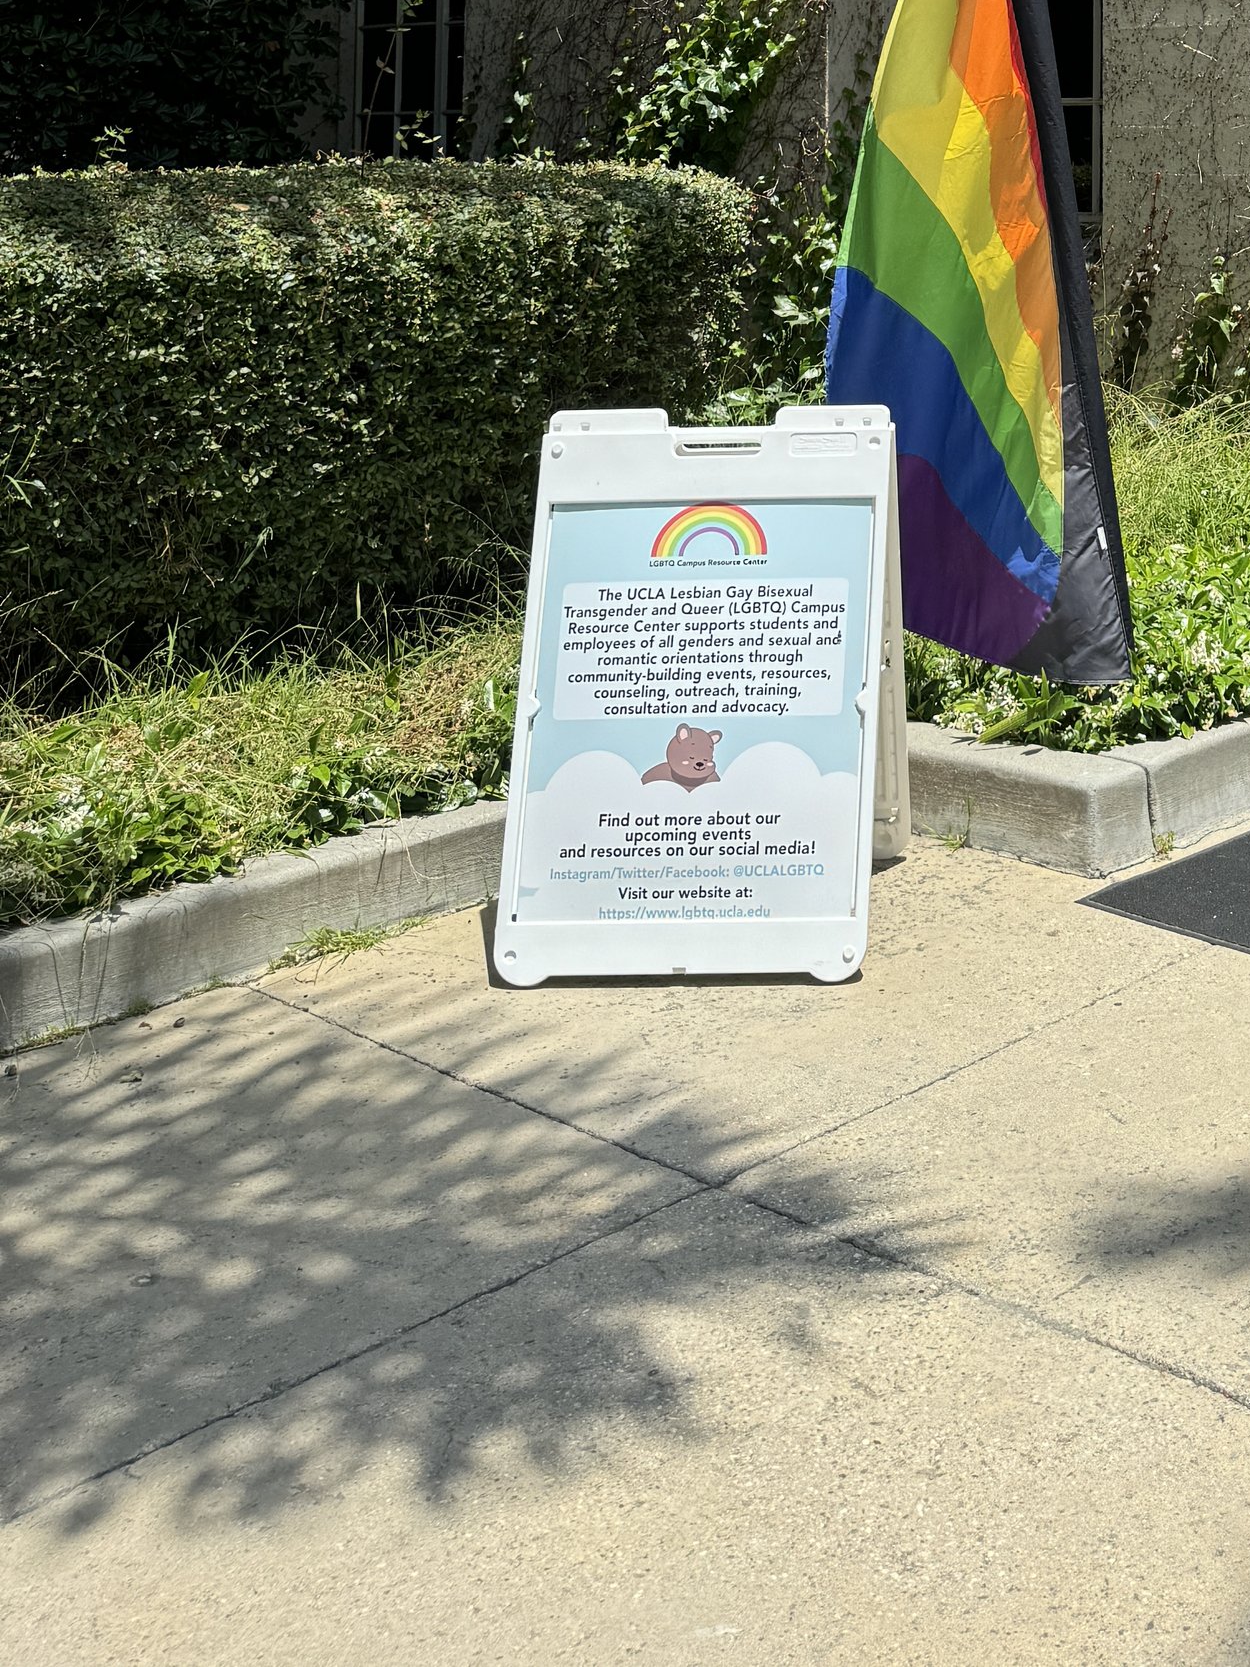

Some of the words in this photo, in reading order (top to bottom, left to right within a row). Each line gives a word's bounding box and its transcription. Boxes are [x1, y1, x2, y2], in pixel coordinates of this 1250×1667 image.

[650, 560, 675, 568] LGBTQ
[677, 560, 706, 568] Campus
[598, 588, 622, 601] The
[628, 588, 666, 600] UCLA
[670, 586, 721, 599] Lesbian
[727, 586, 753, 601] Gay
[758, 584, 813, 597] Bisexual
[564, 604, 648, 621] Transgender
[651, 602, 676, 616] and
[681, 603, 724, 614] Queer
[728, 600, 787, 616] (LGBTQ)
[791, 601, 845, 616] Campus
[568, 622, 629, 634] Resource
[634, 620, 681, 632] Center
[684, 619, 746, 633] supports
[750, 616, 808, 630] students
[814, 616, 838, 629] and
[564, 637, 636, 654] employees
[640, 635, 656, 648] of
[658, 635, 674, 648] all
[678, 634, 734, 651] genders
[739, 633, 764, 646] and
[768, 632, 812, 646] sexual
[816, 631, 842, 646] and
[598, 652, 657, 666] romantic
[662, 650, 745, 665] orientations
[749, 648, 802, 666] through
[568, 668, 702, 685] community-building
[706, 668, 756, 681] events,
[761, 670, 831, 680] resources,
[594, 684, 670, 701] counseling,
[675, 684, 739, 699] outreach,
[744, 683, 801, 699] training,
[604, 701, 687, 715] consultation
[692, 700, 717, 713] and
[722, 700, 790, 716] advocacy.
[599, 812, 630, 827] Find
[635, 814, 660, 826] out
[664, 815, 702, 826] more
[707, 810, 751, 825] about
[756, 814, 781, 824] our
[625, 830, 697, 845] upcoming
[702, 830, 752, 841] events
[560, 844, 586, 858] and
[591, 846, 661, 858] resources
[666, 847, 684, 856] on
[690, 846, 716, 856] our
[718, 841, 760, 856] social
[765, 840, 815, 855] media!
[550, 865, 729, 882] Instagram/Twitter/Facebook:
[734, 864, 824, 878] @UCLALGBTQ
[618, 887, 648, 900] Visit
[652, 890, 675, 899] our
[678, 885, 731, 898] website
[736, 887, 752, 898] at:
[599, 905, 770, 920] https://www.lgbtq.ucla.edu
